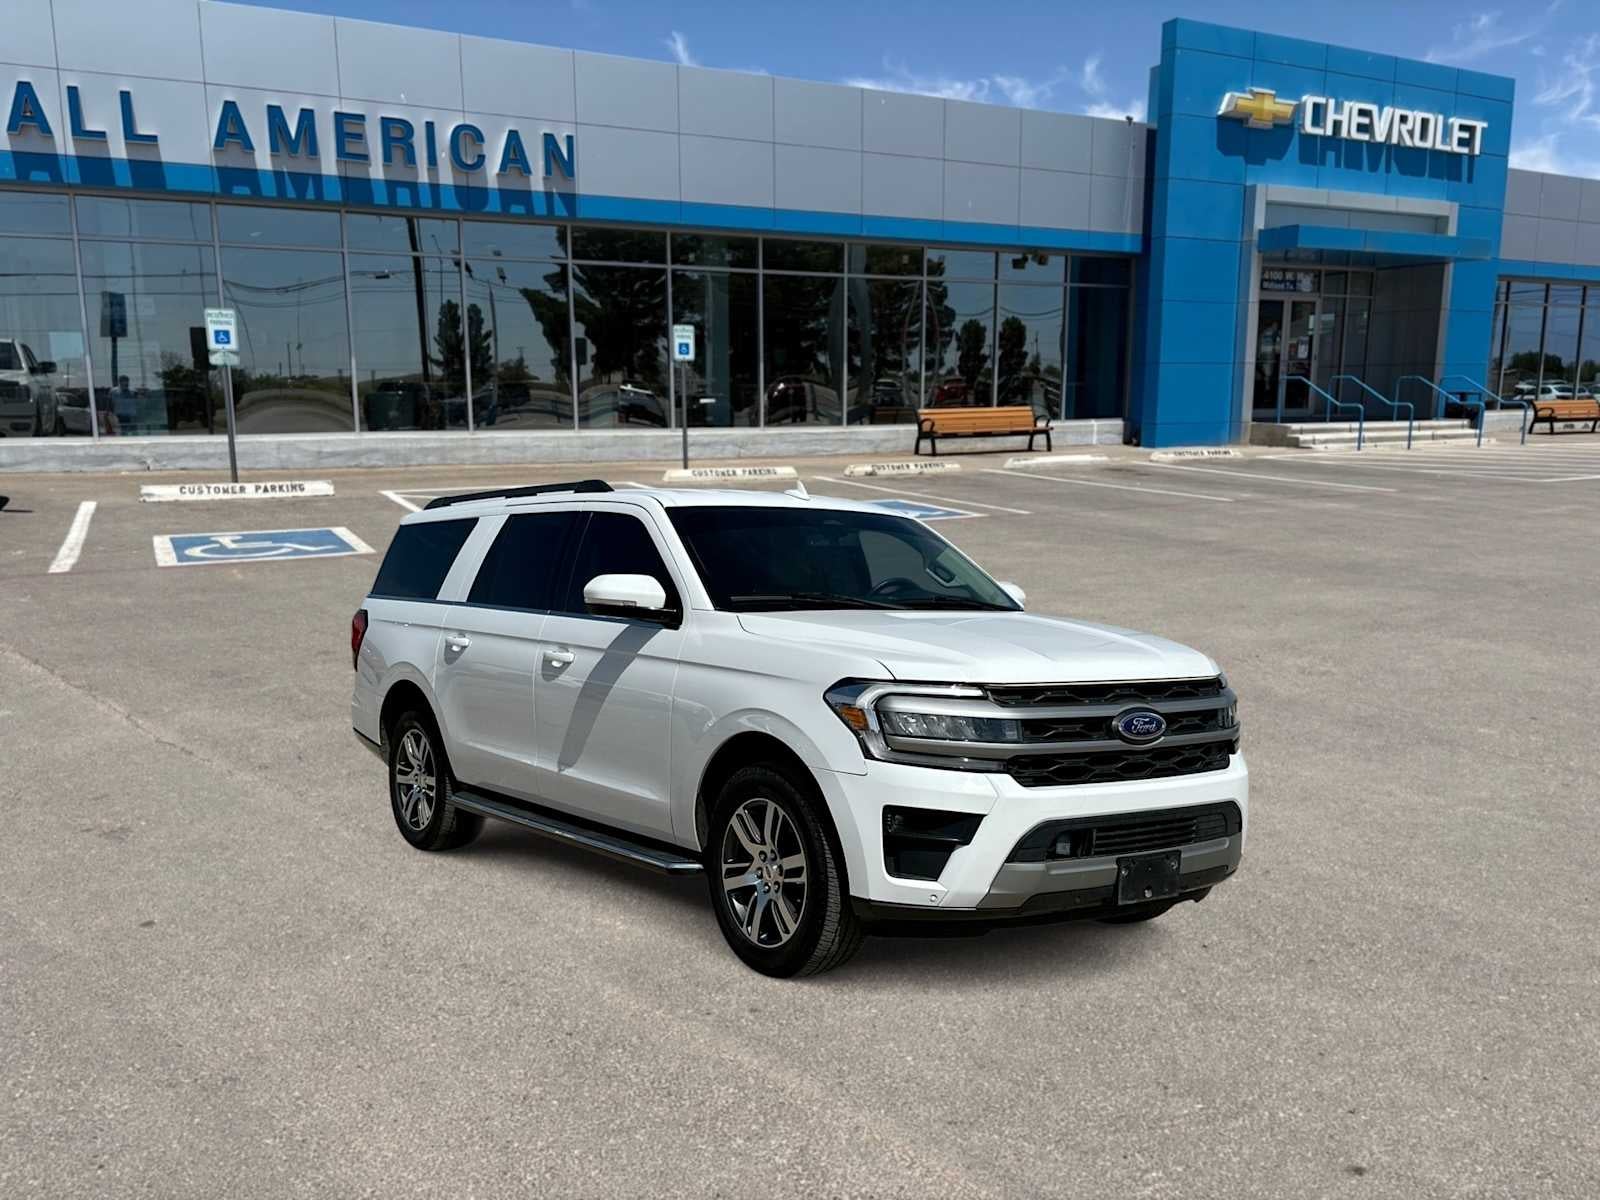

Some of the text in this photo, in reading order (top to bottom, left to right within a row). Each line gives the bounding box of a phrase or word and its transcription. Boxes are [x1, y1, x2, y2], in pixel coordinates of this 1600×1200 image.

[6, 80, 576, 179] ALL AMERICAN
[1301, 94, 1489, 156] CHEVROLET
[691, 467, 778, 478] CUSTOMER PARKING
[179, 483, 306, 496] CUSTOMER PARKING
[1131, 717, 1158, 733] Ford
